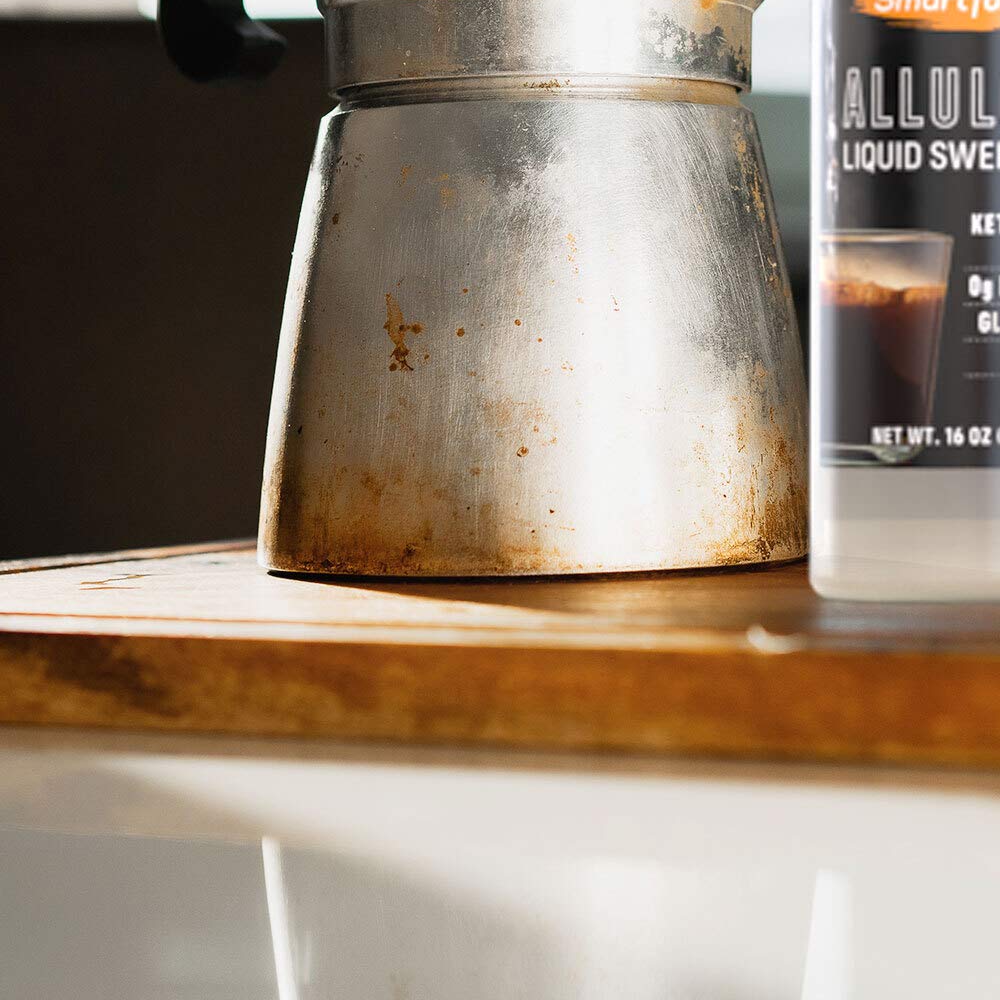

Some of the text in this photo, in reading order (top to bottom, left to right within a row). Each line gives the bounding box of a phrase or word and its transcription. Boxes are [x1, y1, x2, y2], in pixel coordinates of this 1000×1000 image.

[842, 140, 922, 174] LIQUID
[871, 426, 903, 445] NET
[907, 426, 940, 445] WT.
[945, 426, 965, 445] 16
[968, 426, 992, 445] OZ
